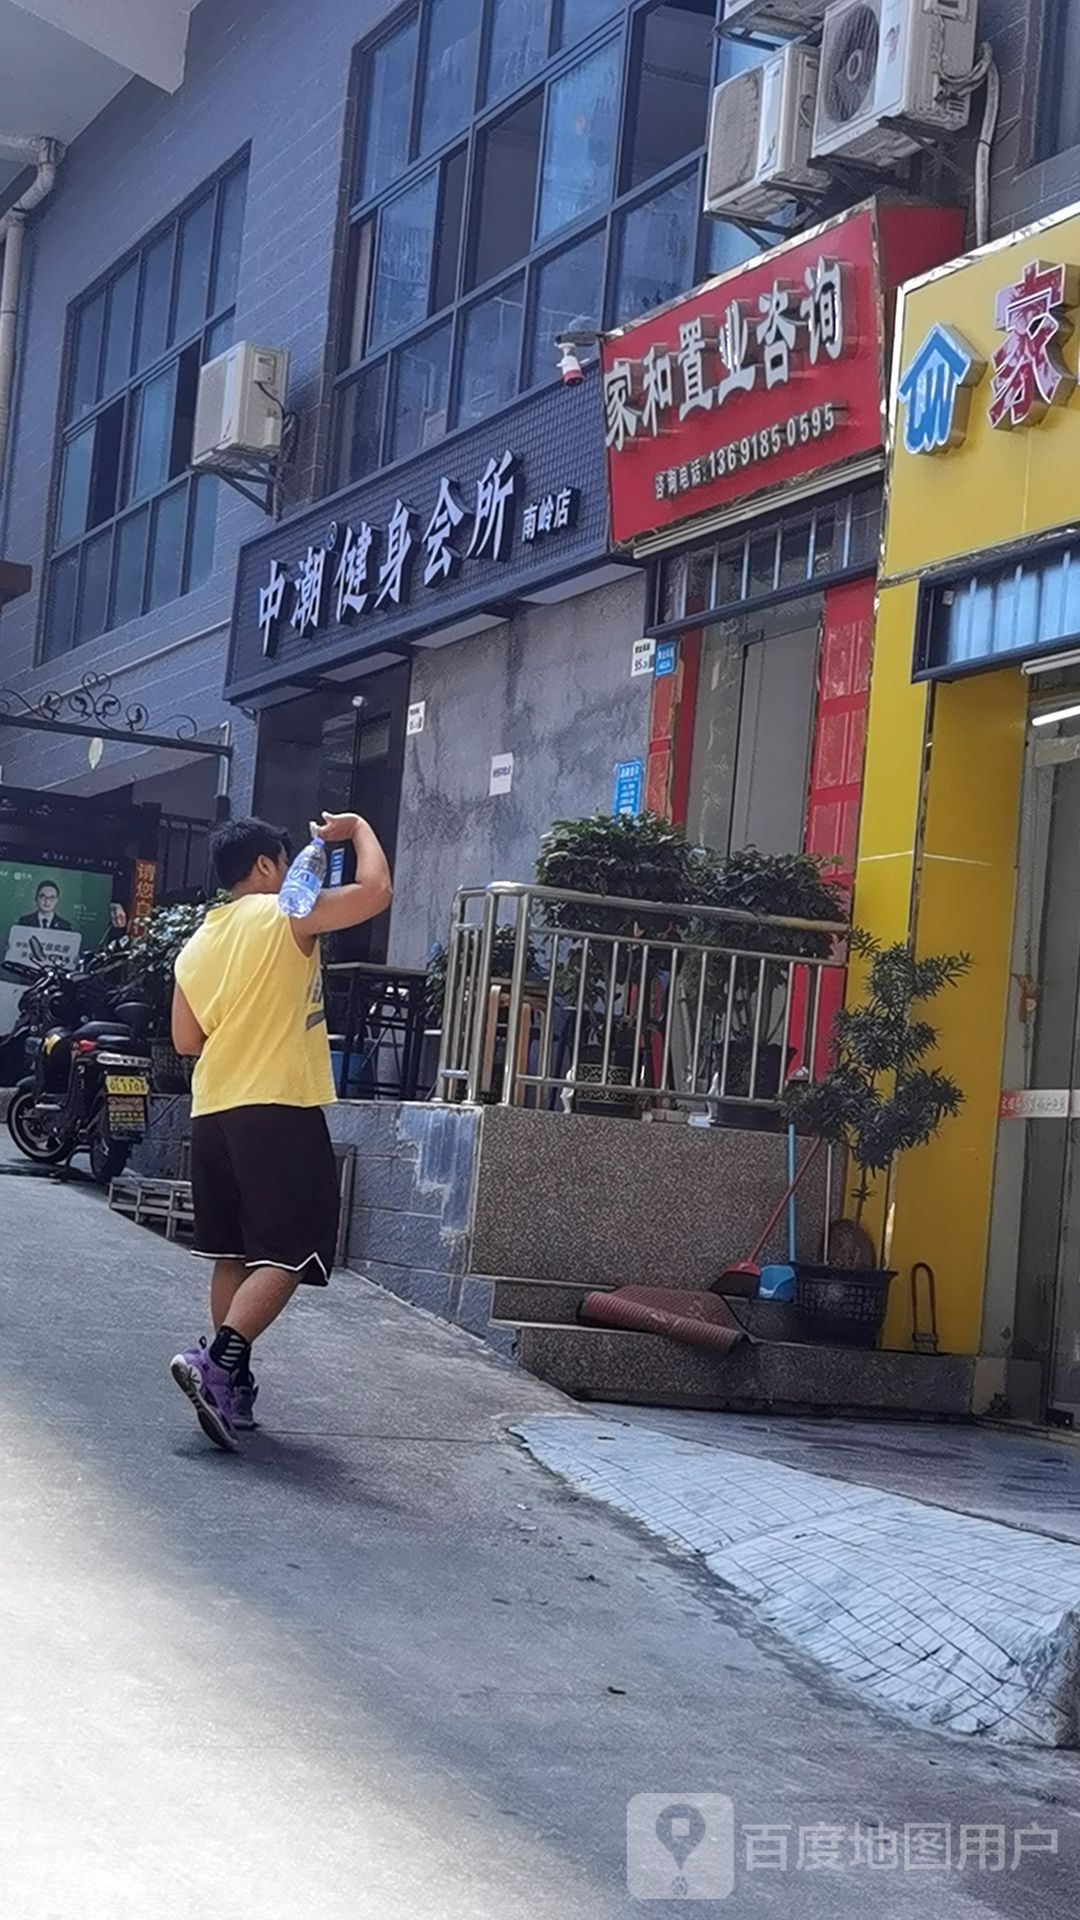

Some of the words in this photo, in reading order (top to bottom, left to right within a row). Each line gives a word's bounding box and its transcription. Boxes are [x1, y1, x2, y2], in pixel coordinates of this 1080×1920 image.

[604, 256, 842, 452] 家和置业咨询
[987, 259, 1066, 428] 家
[258, 449, 515, 656] 中潮健身会所
[521, 487, 572, 542] 南岭店
